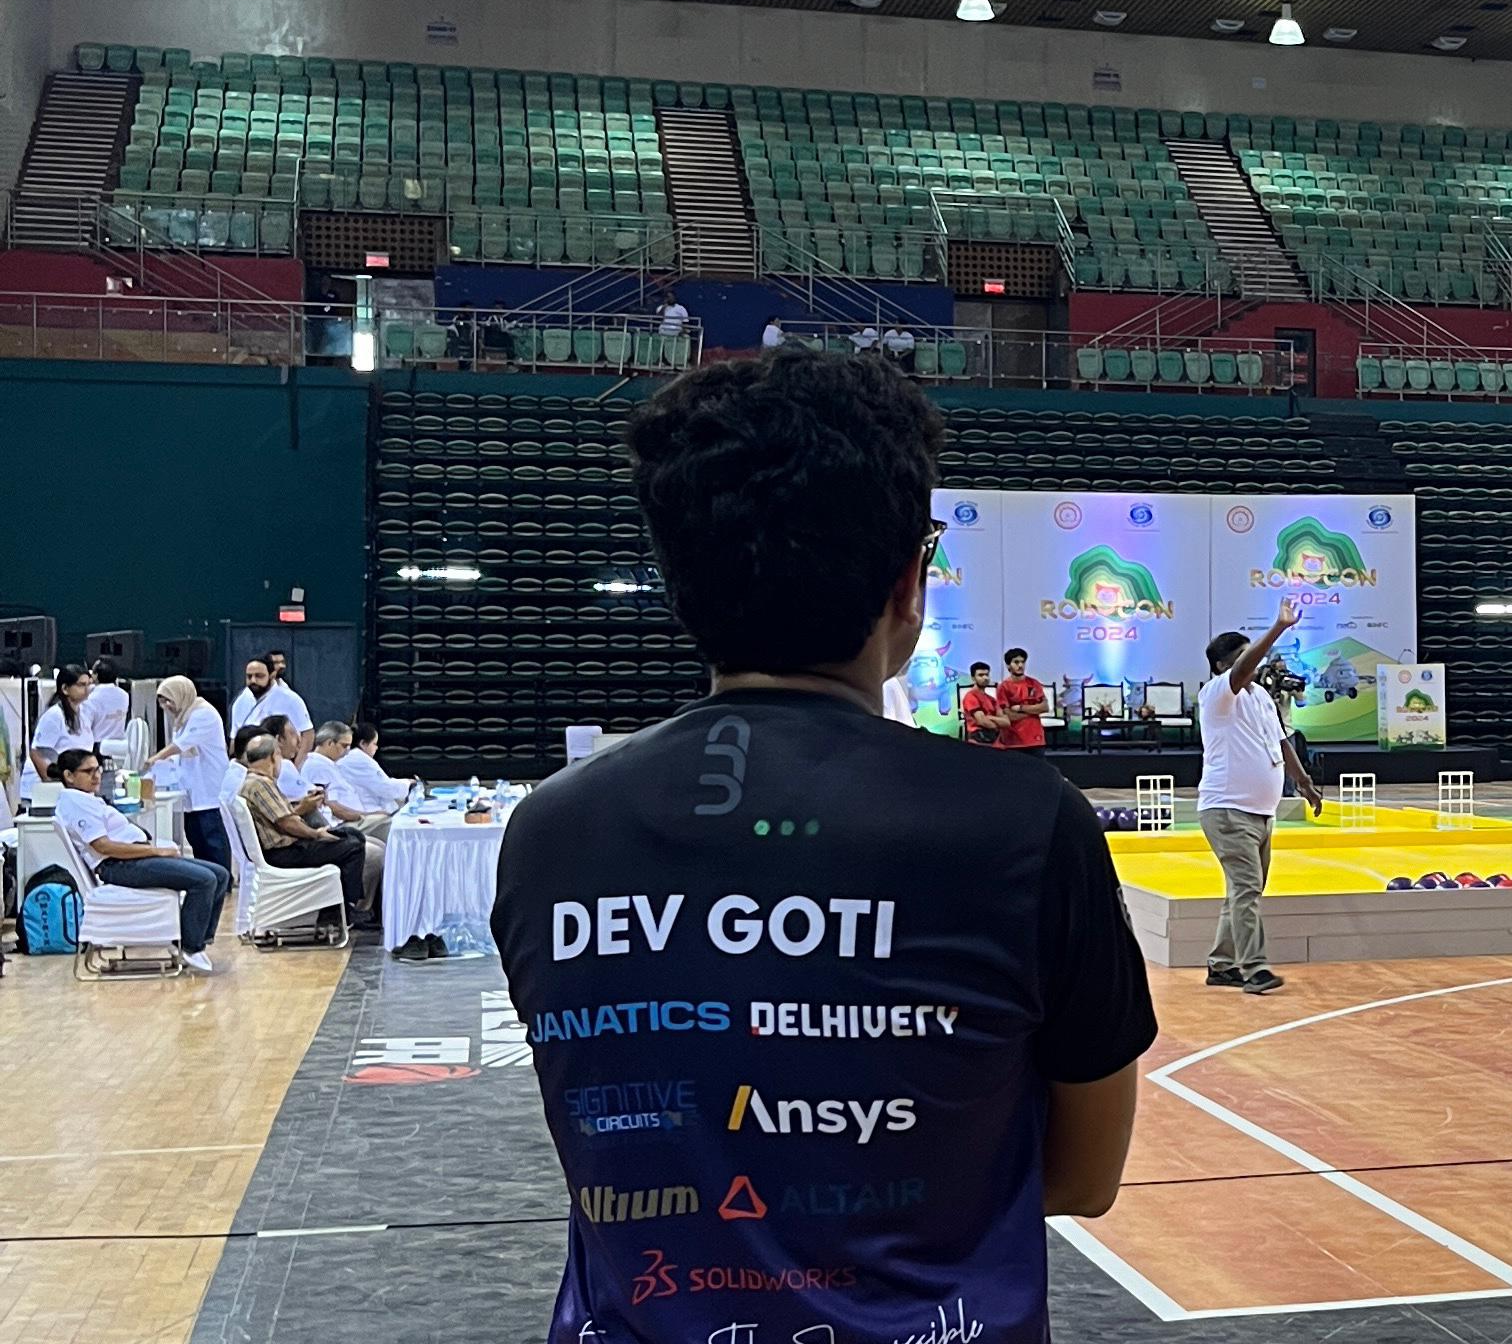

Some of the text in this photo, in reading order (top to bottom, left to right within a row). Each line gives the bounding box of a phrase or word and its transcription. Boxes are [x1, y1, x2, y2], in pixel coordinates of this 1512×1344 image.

[1287, 592, 1341, 605] 2024
[1077, 626, 1138, 641] 2024
[552, 894, 896, 962] DEV GOTI
[530, 1001, 730, 1044] JANATICS
[596, 1112, 660, 1132] CIRCUITS
[727, 1085, 918, 1144] Ansys
[780, 1179, 927, 1216] ALTAIR
[689, 1266, 858, 1293] SOLIDWORKS
